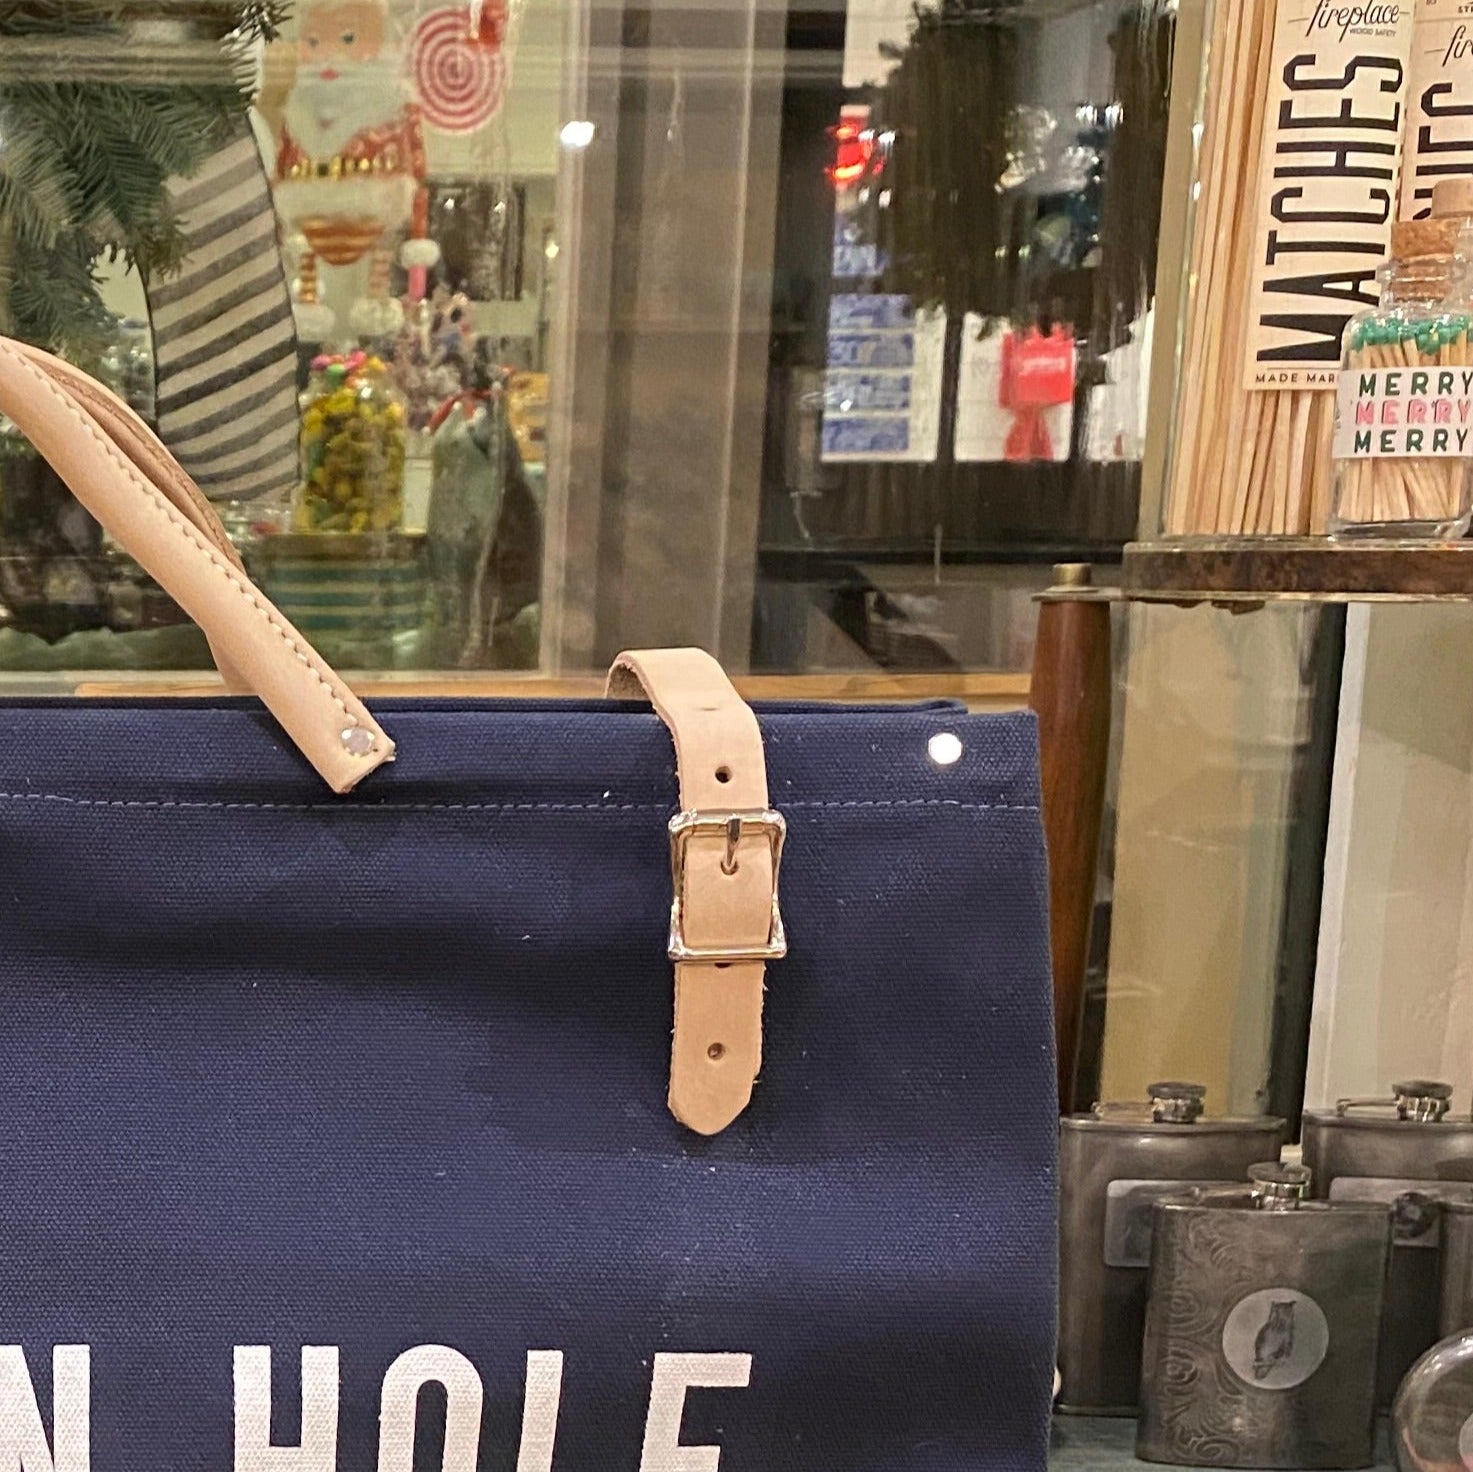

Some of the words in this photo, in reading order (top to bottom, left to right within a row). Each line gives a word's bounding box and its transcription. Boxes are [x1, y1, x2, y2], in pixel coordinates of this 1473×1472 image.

[1256, 54, 1403, 362] MATCHES
[1255, 373, 1298, 383] MADE
[1306, 373, 1339, 383] MAR
[1359, 371, 1473, 397] MERRY
[1355, 399, 1471, 426] MERRY
[1354, 429, 1469, 454] MERRY
